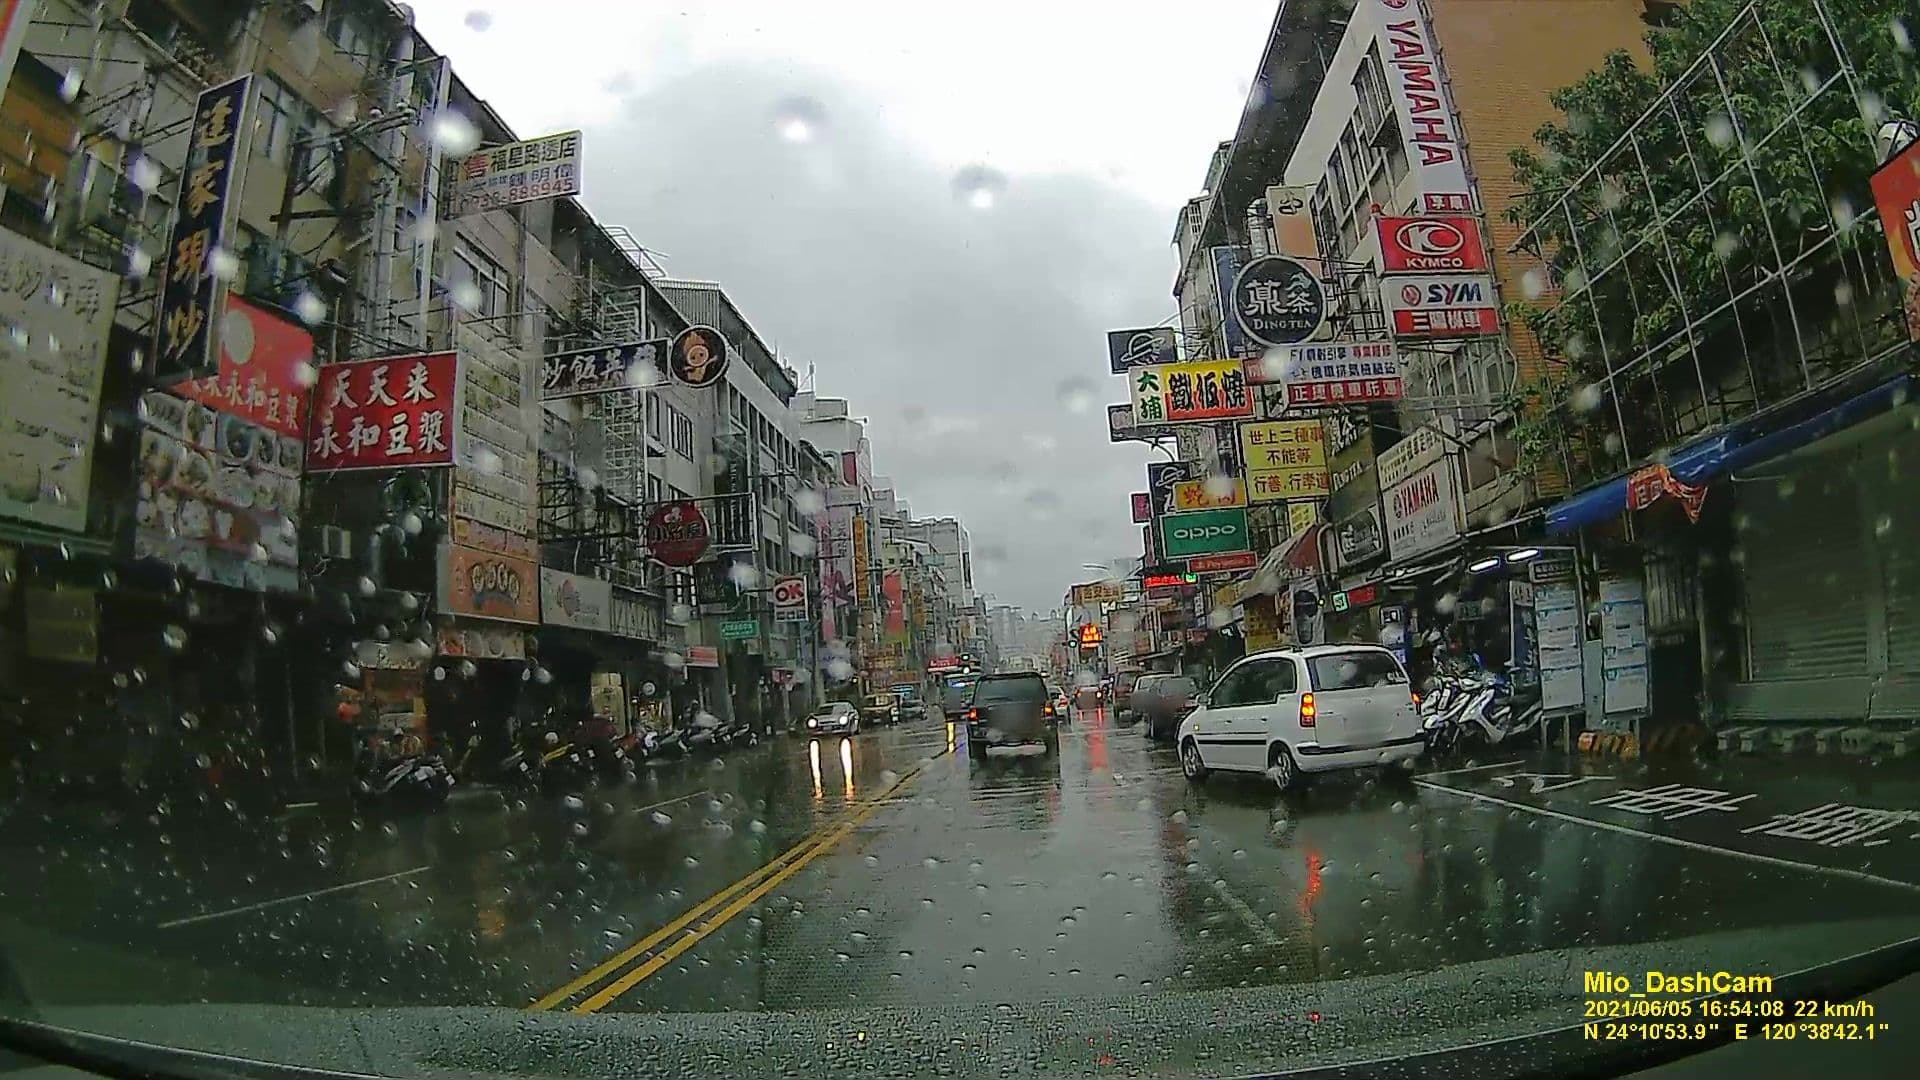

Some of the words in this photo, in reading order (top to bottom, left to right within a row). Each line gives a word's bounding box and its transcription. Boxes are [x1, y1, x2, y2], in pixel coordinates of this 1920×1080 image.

[1386, 20, 1454, 167] YAMAHA
[1405, 258, 1464, 268] KYMCO
[1427, 282, 1483, 306] SYM
[313, 410, 448, 459] 永和豆漿
[1267, 447, 1311, 465] 不能等
[1401, 472, 1440, 518] YAMAHA
[775, 583, 804, 602] OK
